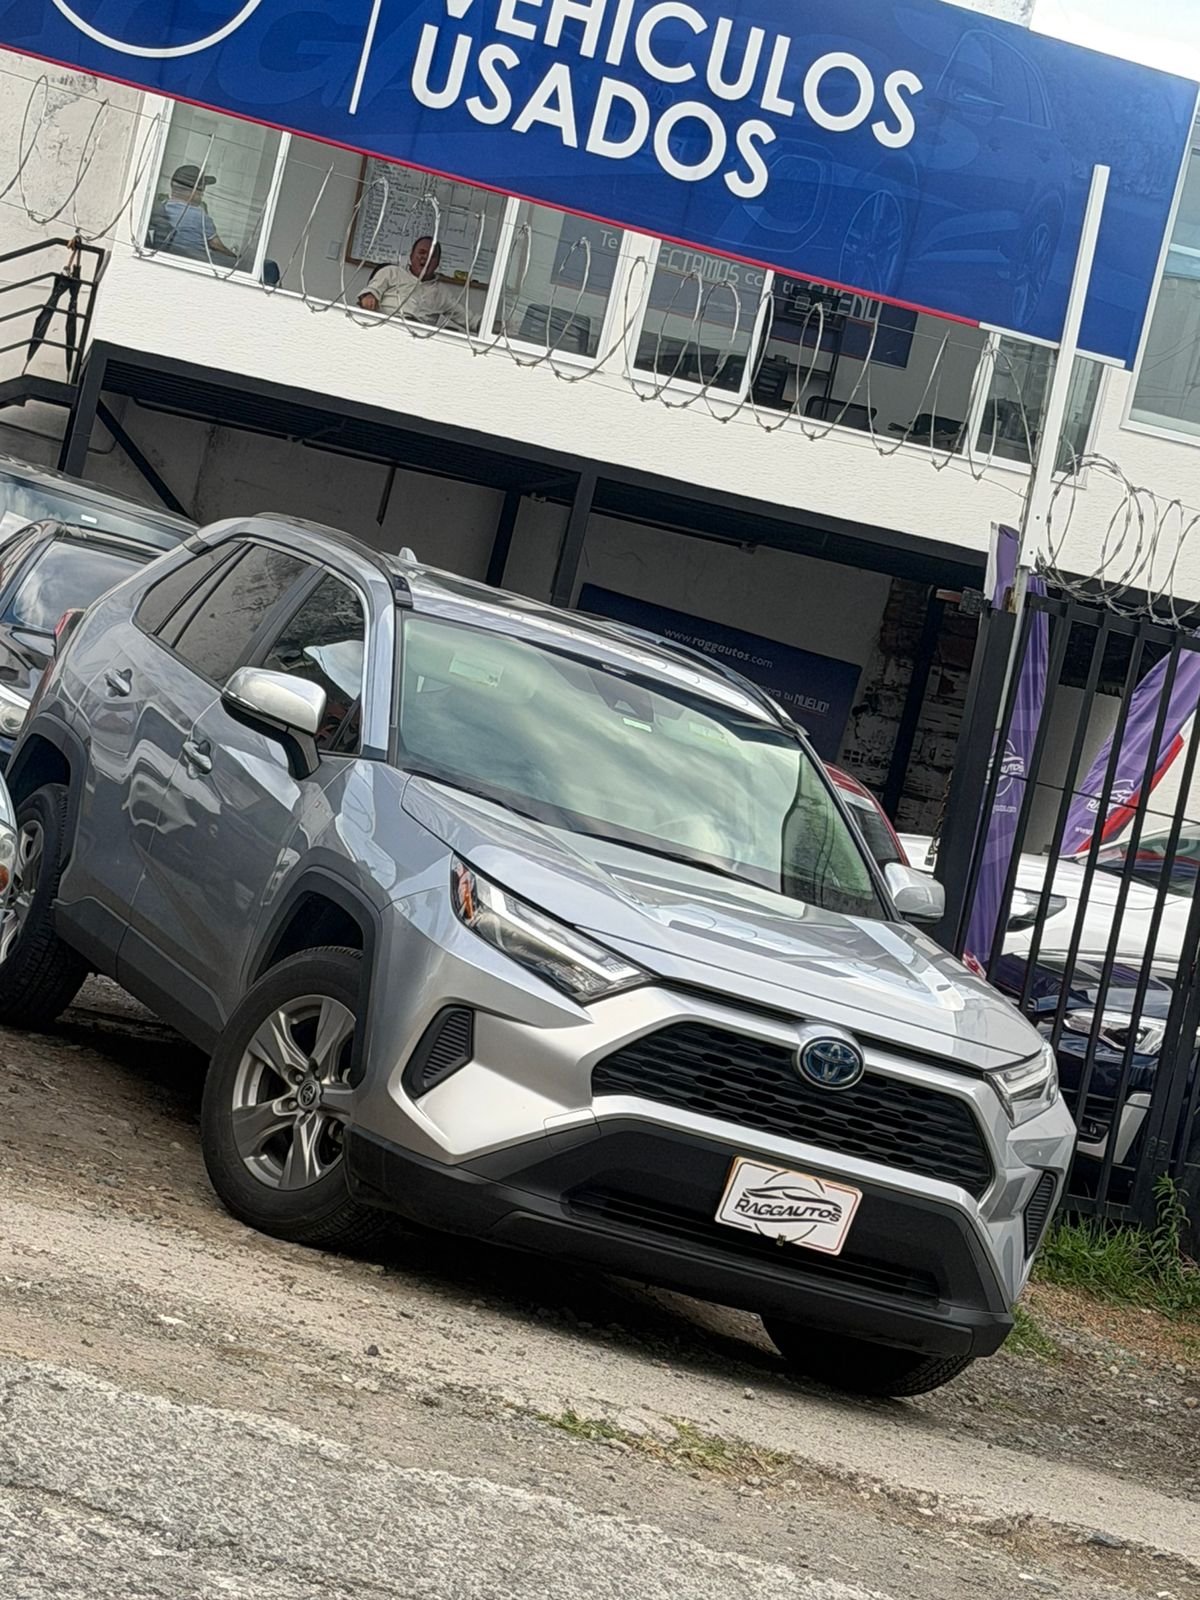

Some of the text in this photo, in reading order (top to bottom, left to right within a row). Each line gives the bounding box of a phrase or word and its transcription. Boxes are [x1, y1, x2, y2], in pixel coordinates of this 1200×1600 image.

[446, 0, 923, 149] EHICULOS
[411, 24, 776, 199] USADOS
[601, 230, 618, 249] Te
[663, 628, 773, 669] www.raggautos.com
[734, 1197, 842, 1223] RAGGAUTOS
